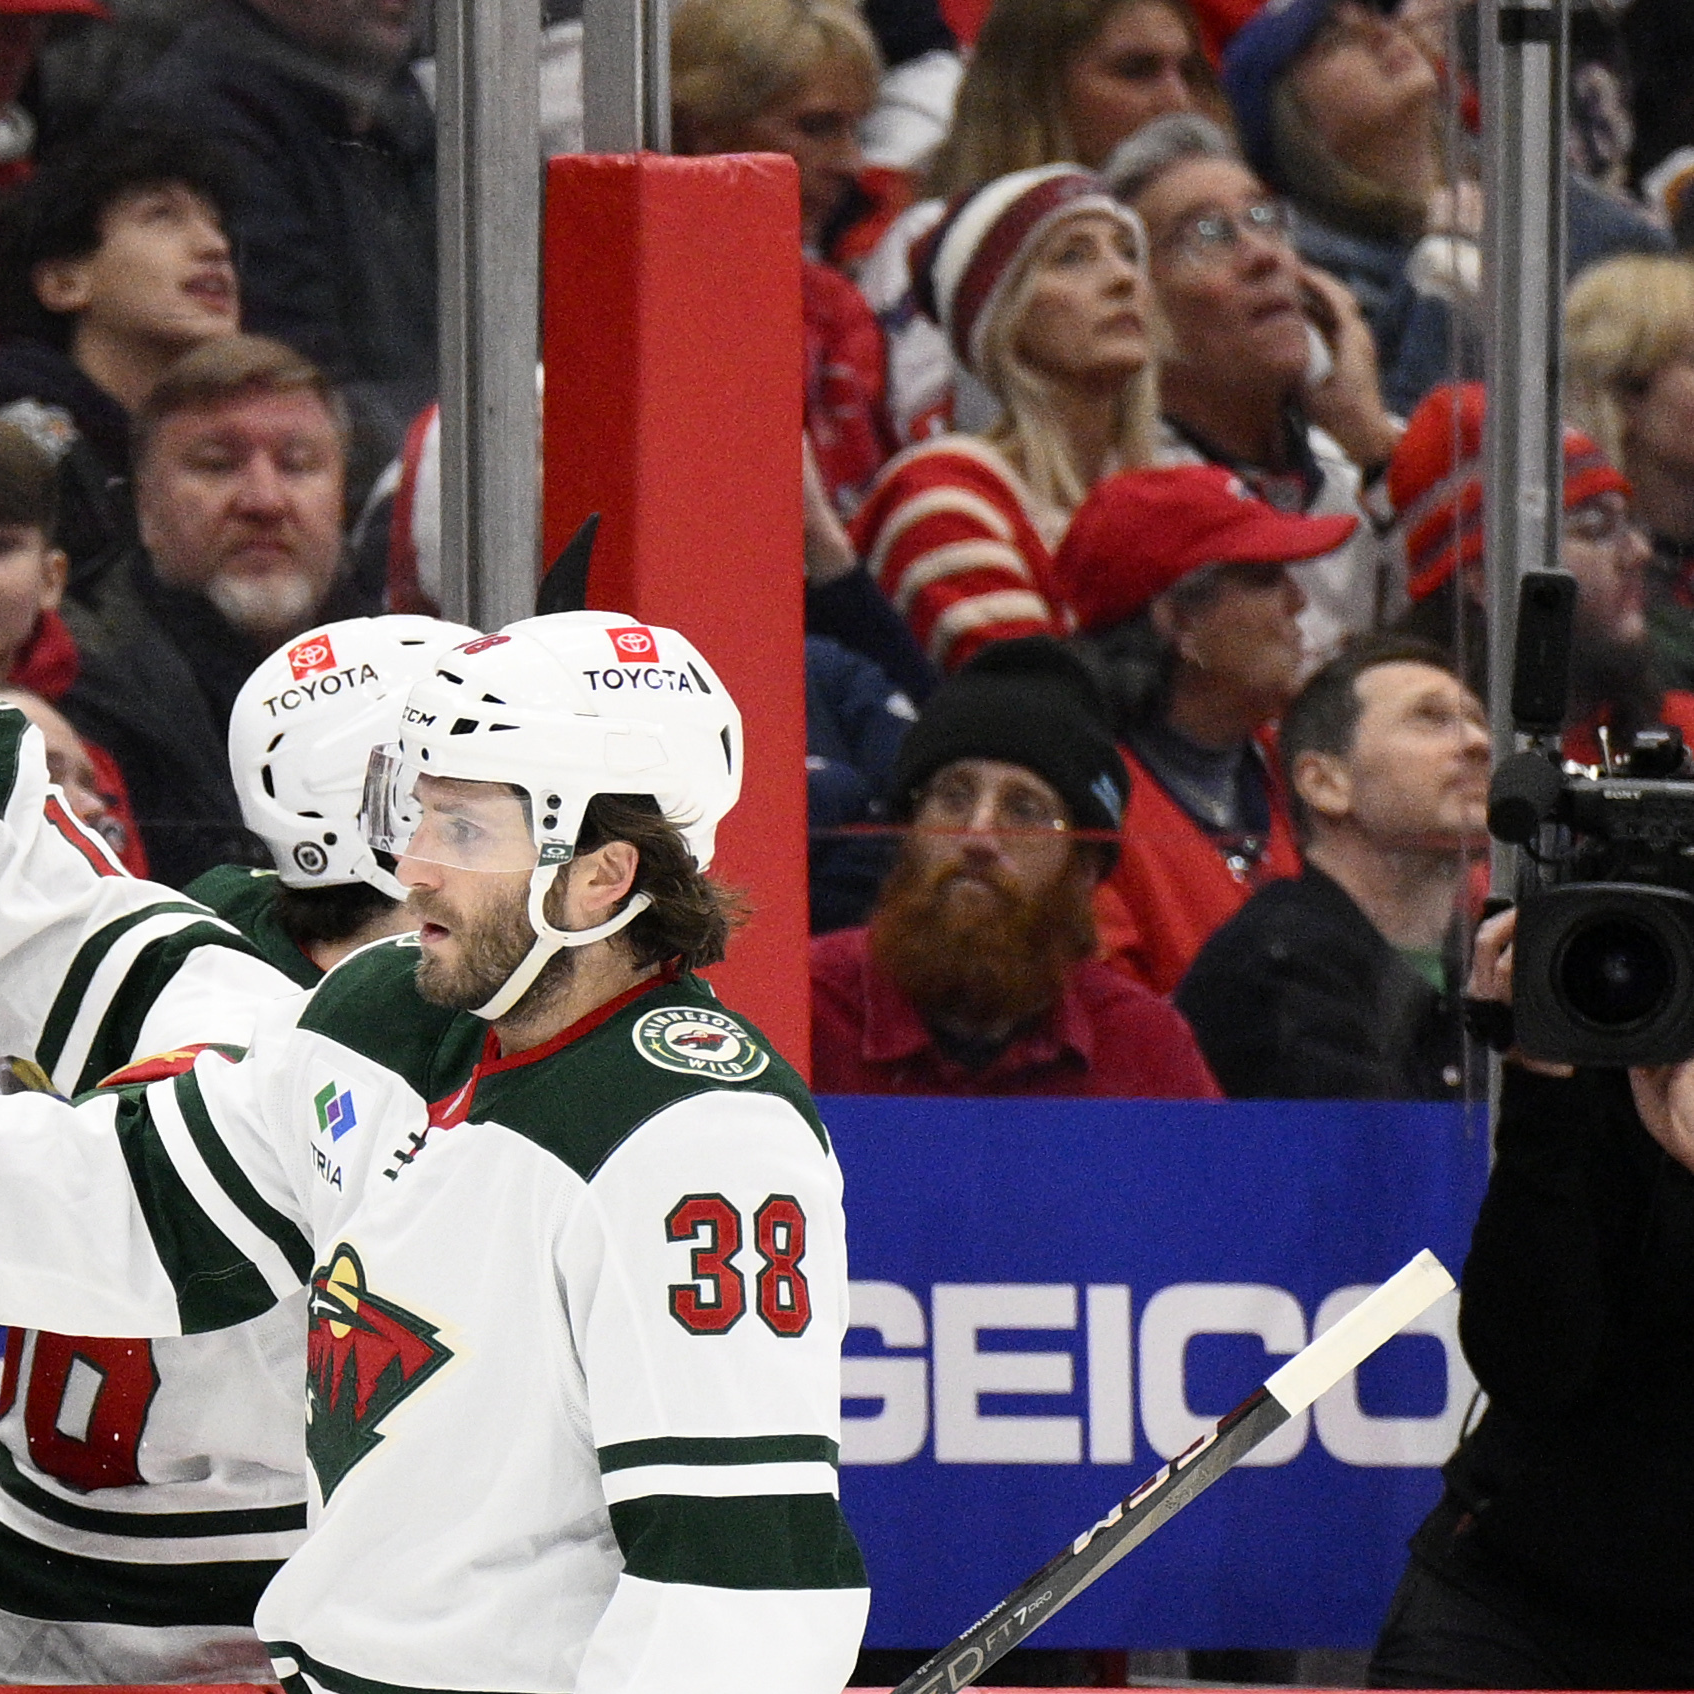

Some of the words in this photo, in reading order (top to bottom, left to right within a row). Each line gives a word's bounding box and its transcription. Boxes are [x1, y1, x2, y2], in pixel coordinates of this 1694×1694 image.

[263, 663, 379, 717] TOYOTA
[583, 668, 692, 693] TOYOTA
[644, 1011, 749, 1039] MINNESOTA
[688, 1058, 744, 1074] WILD
[310, 1140, 343, 1193] TRIA
[664, 1192, 812, 1338] 38
[839, 1280, 1478, 1467] GEICO
